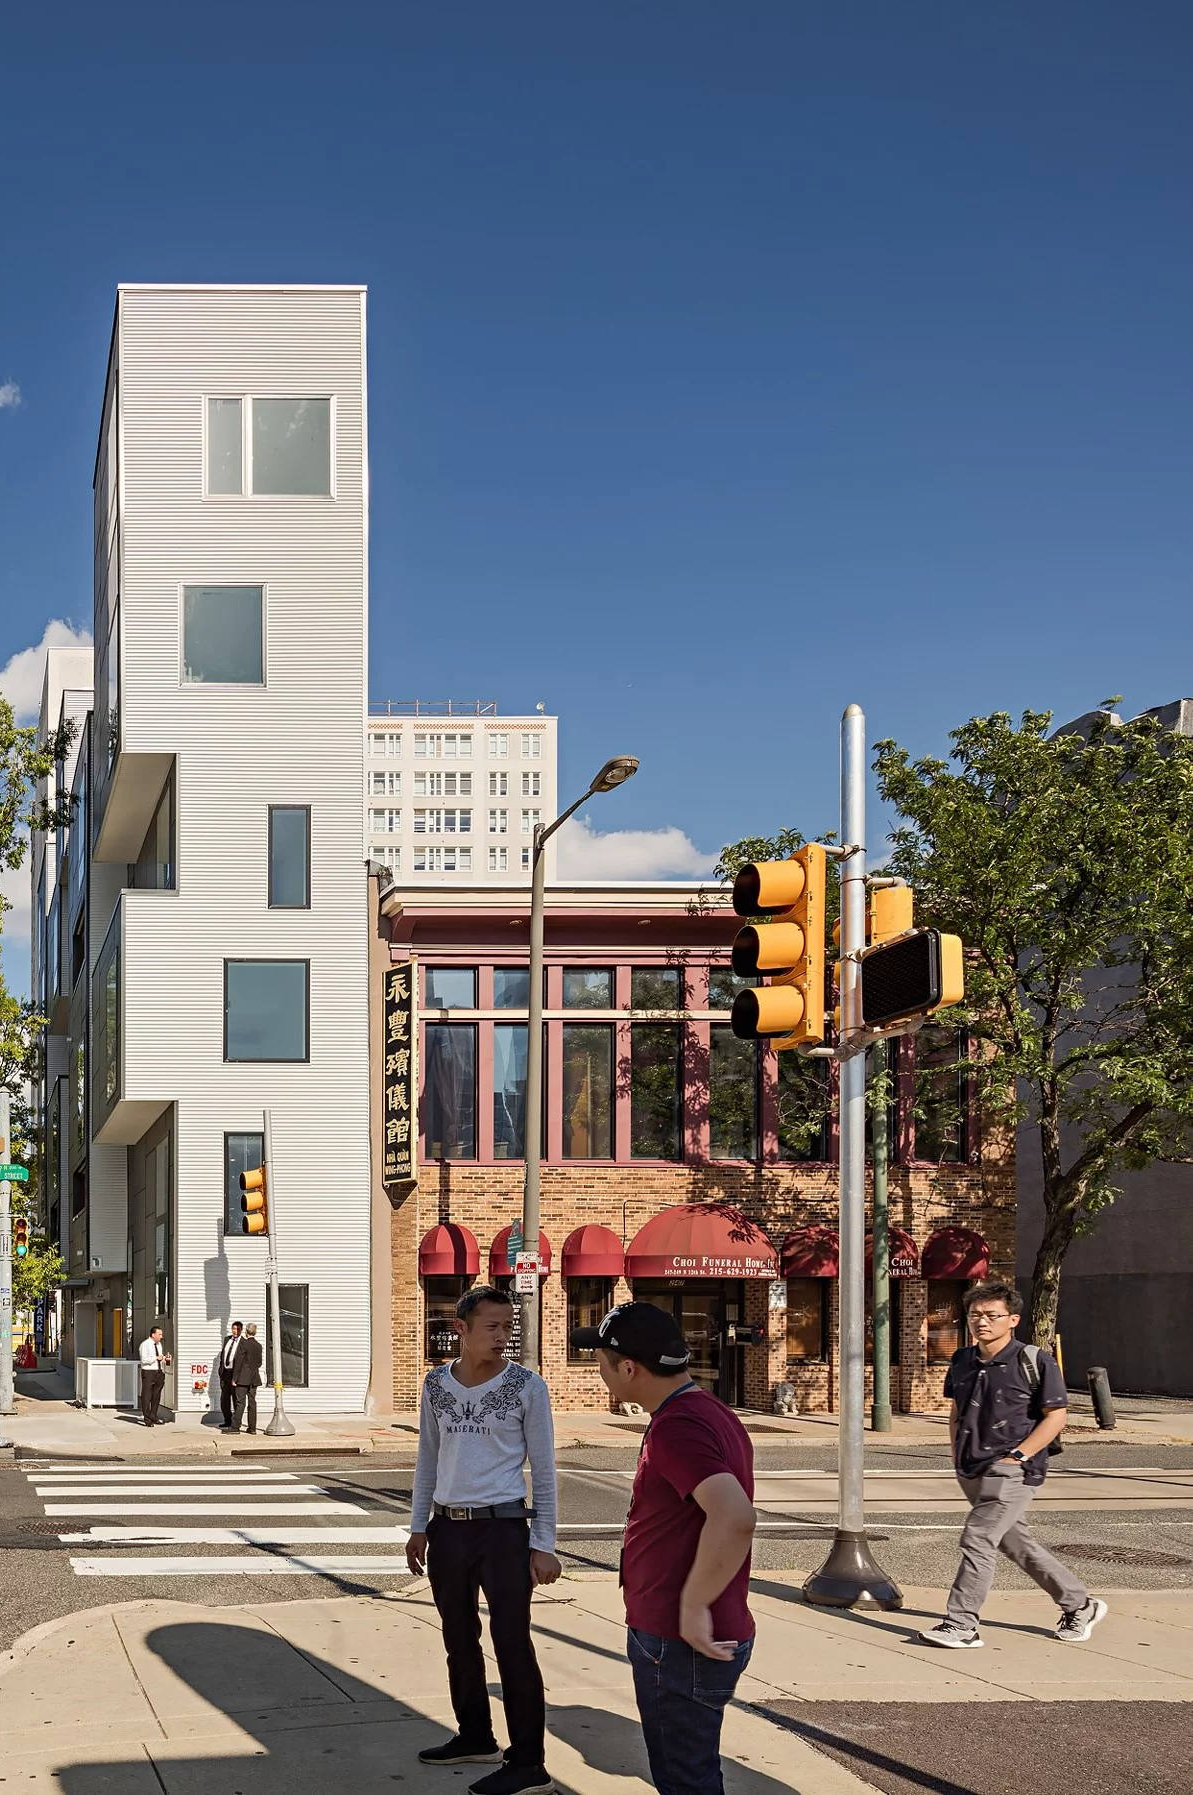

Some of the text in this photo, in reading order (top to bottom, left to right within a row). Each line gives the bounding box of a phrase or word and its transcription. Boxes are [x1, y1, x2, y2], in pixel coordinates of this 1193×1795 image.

[385, 974, 410, 1145] 永豐殯儀館
[673, 1257, 696, 1267] CHOI
[702, 1257, 742, 1267] FUNERAL
[891, 1257, 913, 1267] CHOI
[709, 1268, 757, 1276] 215-629-1923
[191, 1364, 208, 1374] FDC
[446, 1424, 491, 1436] MASERATI
